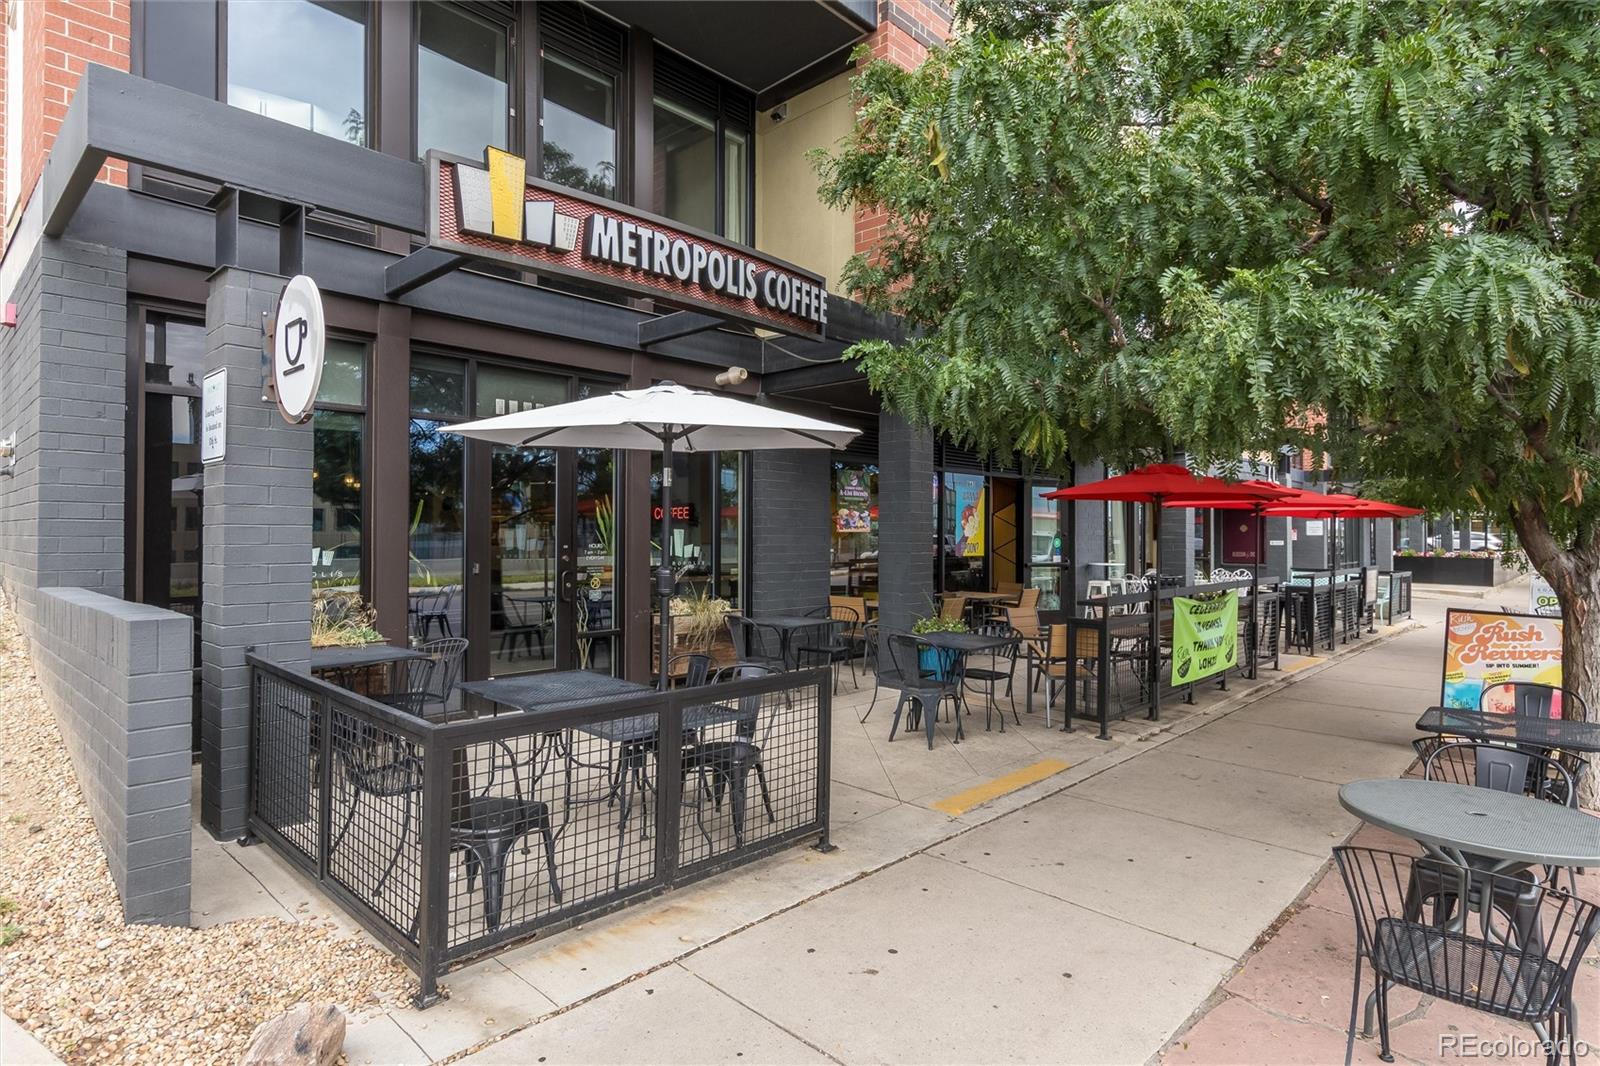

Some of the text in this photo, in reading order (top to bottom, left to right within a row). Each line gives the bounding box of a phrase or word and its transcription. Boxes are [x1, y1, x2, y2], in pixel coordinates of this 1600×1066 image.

[590, 214, 828, 324] METROPOLIS COFFEE
[654, 507, 689, 519] CFEE
[1474, 620, 1544, 644] Rush
[1460, 644, 1562, 664] Revivers
